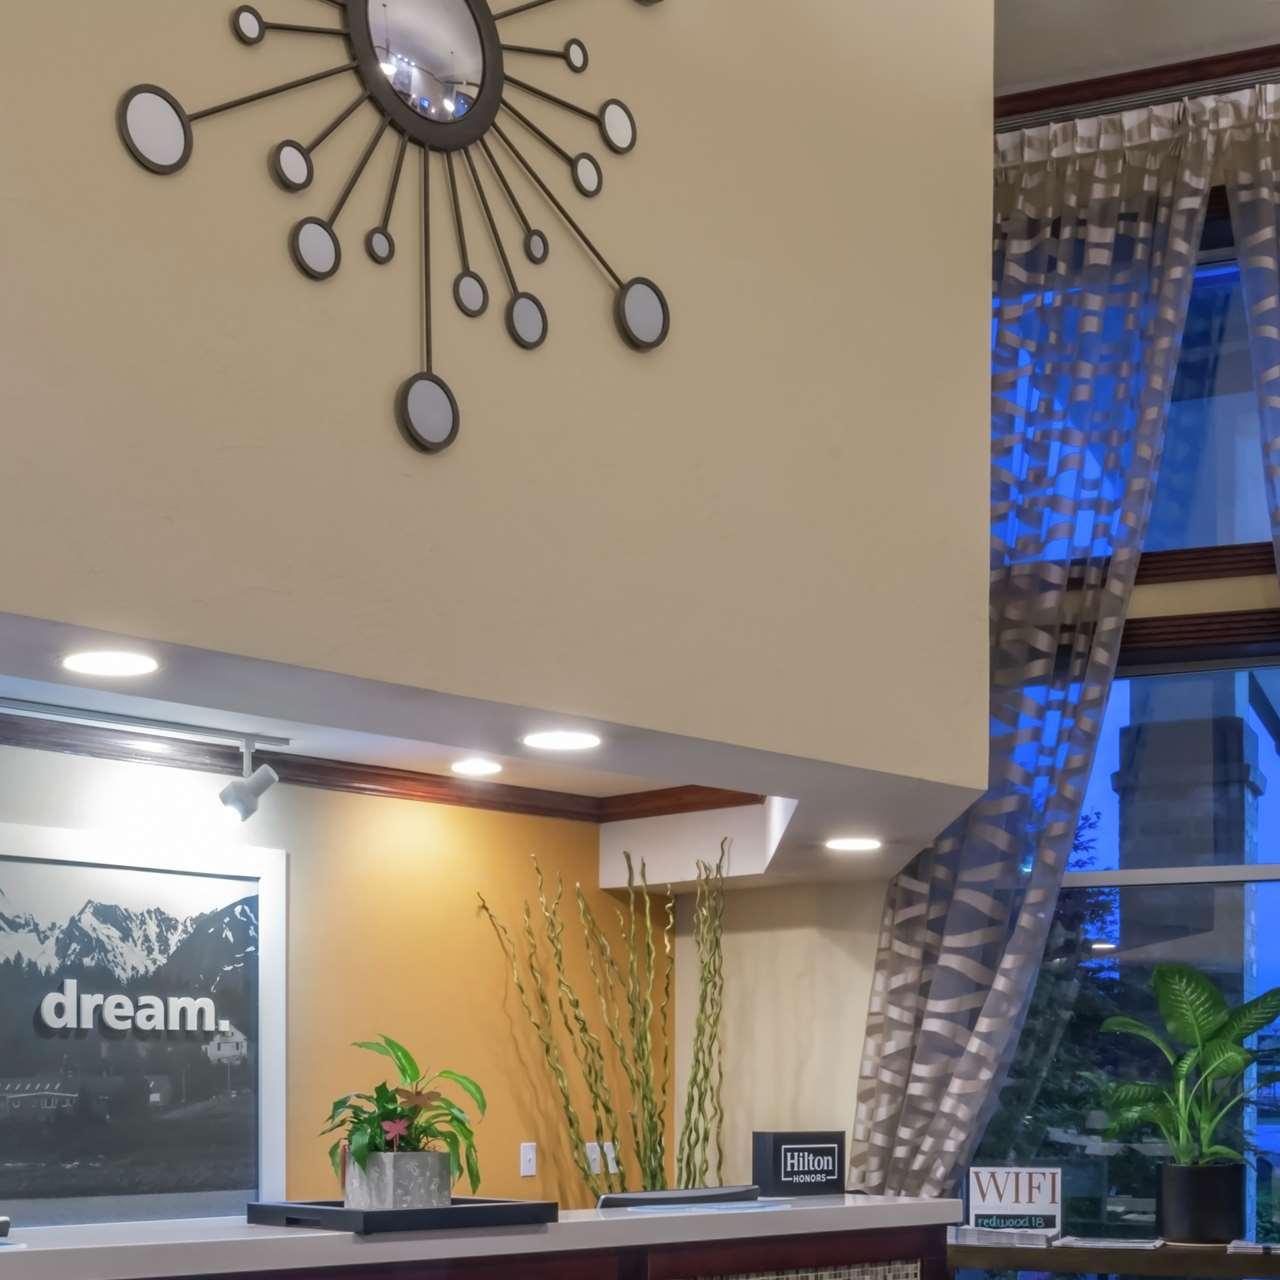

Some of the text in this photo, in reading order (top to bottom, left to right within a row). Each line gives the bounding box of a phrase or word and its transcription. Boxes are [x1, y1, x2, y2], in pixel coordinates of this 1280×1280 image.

[40, 978, 230, 1031] dream.
[786, 1152, 833, 1171] Hilton
[793, 1174, 827, 1184] HONORS
[973, 1171, 1058, 1205] WIFI
[977, 1215, 1045, 1228] redwood 18
